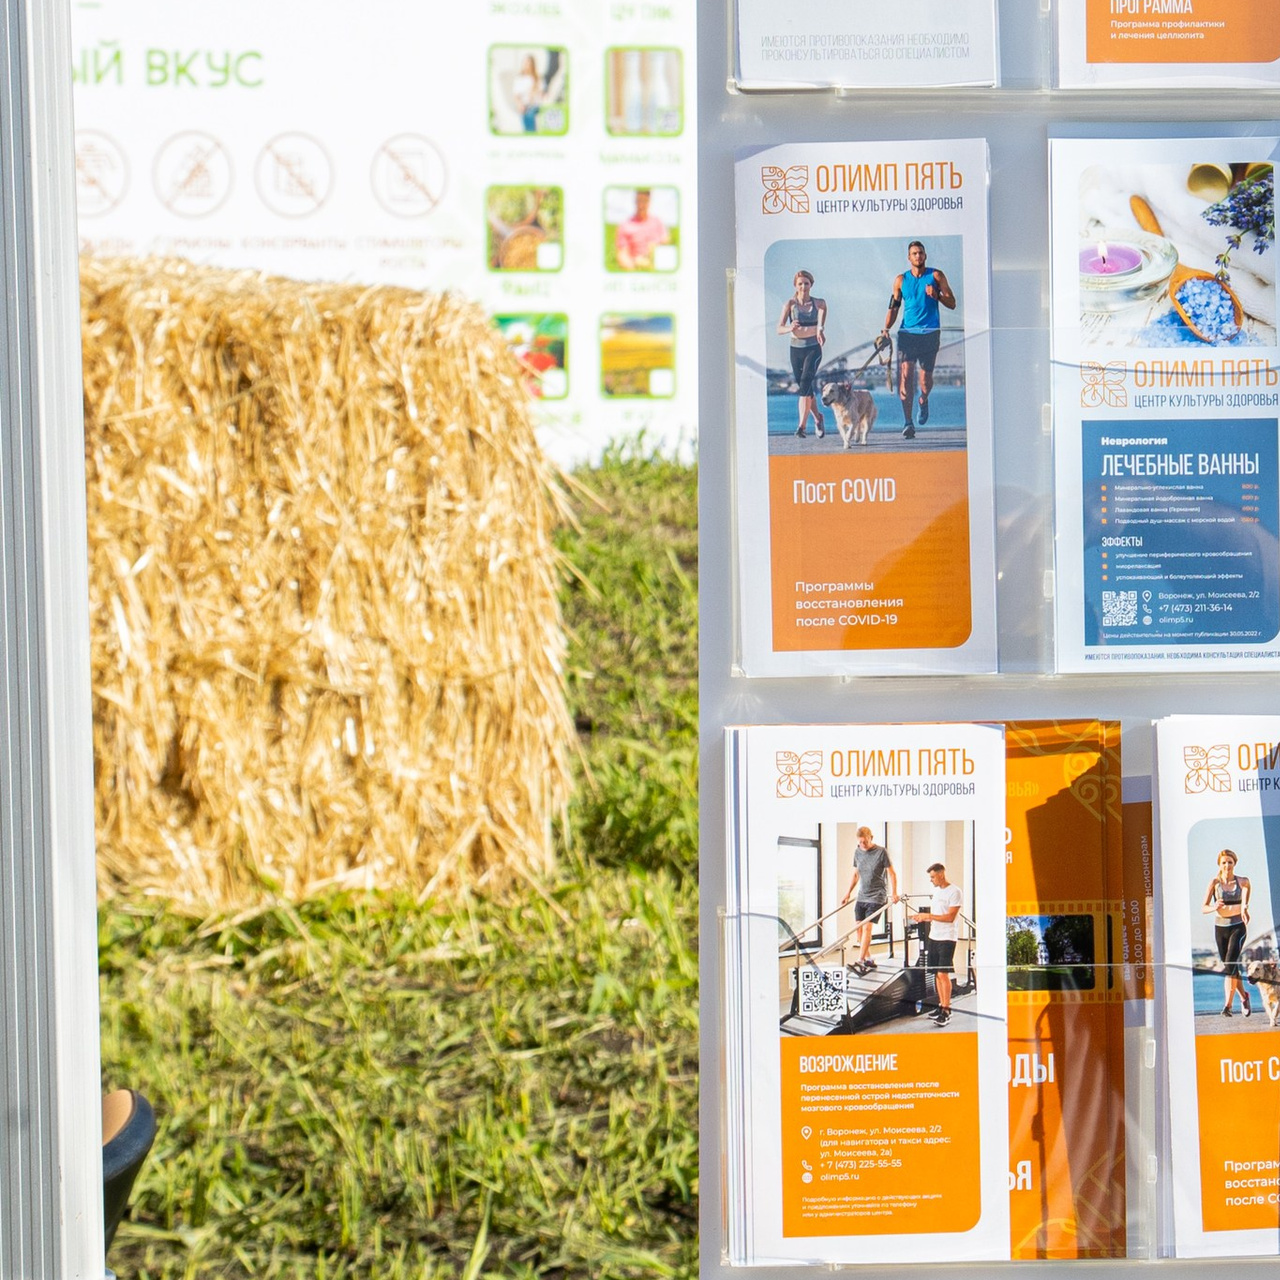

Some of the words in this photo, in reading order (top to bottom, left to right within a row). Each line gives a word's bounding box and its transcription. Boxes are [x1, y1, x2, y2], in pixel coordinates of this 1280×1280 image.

[145, 49, 264, 88] ВКУС
[816, 163, 897, 193] ОЛИМП
[906, 162, 962, 190] ПЯТЬ
[1101, 437, 1168, 447] Неврология
[1101, 453, 1193, 477] ЛЕЧЕБНЫЕ
[1199, 453, 1259, 475] ВАННЫ
[841, 478, 896, 502] COVID
[795, 581, 874, 593] Программы
[795, 598, 903, 610] восстановления
[796, 617, 835, 626] после
[839, 614, 898, 626] COVID-19
[799, 1054, 898, 1074] ВОЗРОЖДЕНИЕ
